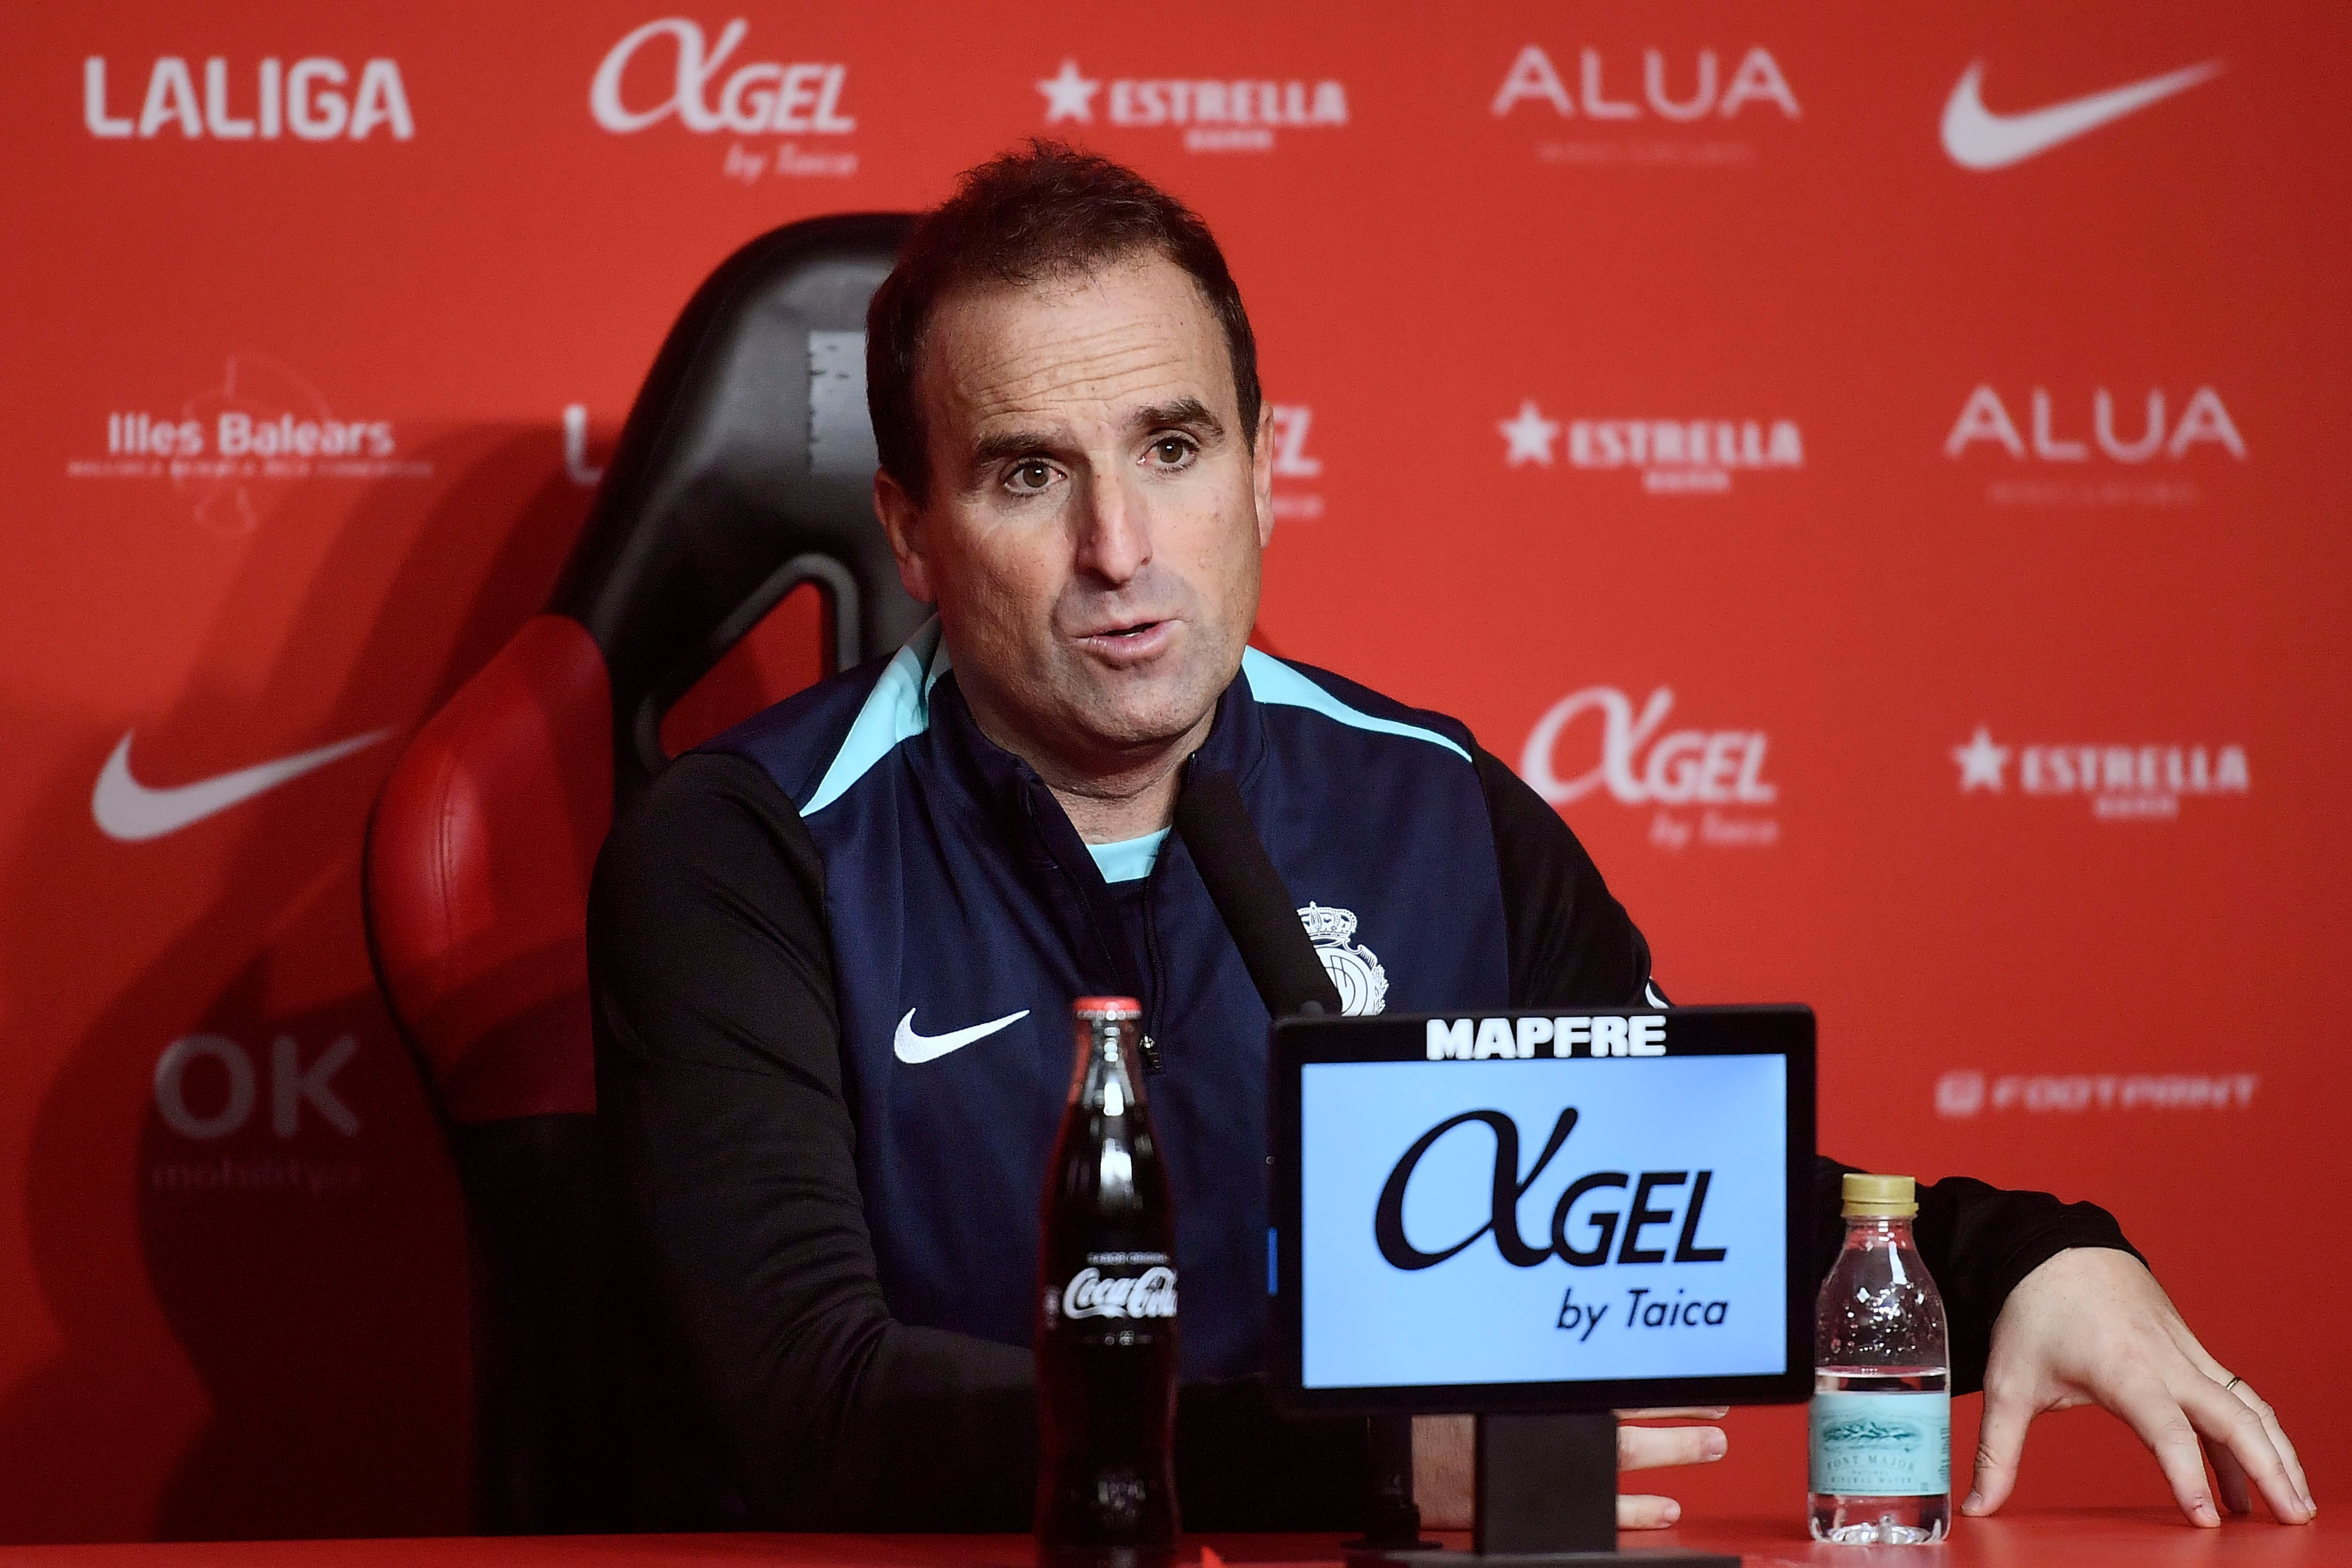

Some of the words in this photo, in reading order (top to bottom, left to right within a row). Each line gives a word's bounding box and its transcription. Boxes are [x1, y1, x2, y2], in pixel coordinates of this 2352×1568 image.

[85, 56, 414, 141] LALIGA
[1109, 81, 1346, 125] ESTRELLA
[1492, 45, 1800, 121] ALUA
[108, 413, 203, 455] Illes
[218, 412, 393, 456] Balears
[1569, 422, 1802, 466] ESTRELLA
[1945, 385, 2246, 462] ALUA
[2022, 747, 2248, 792] ESTRELLA
[1426, 1015, 1666, 1060] MAPFRE
[154, 1034, 360, 1138] OK
[1556, 1286, 1609, 1343] by
[1626, 1287, 1729, 1329] Taica
